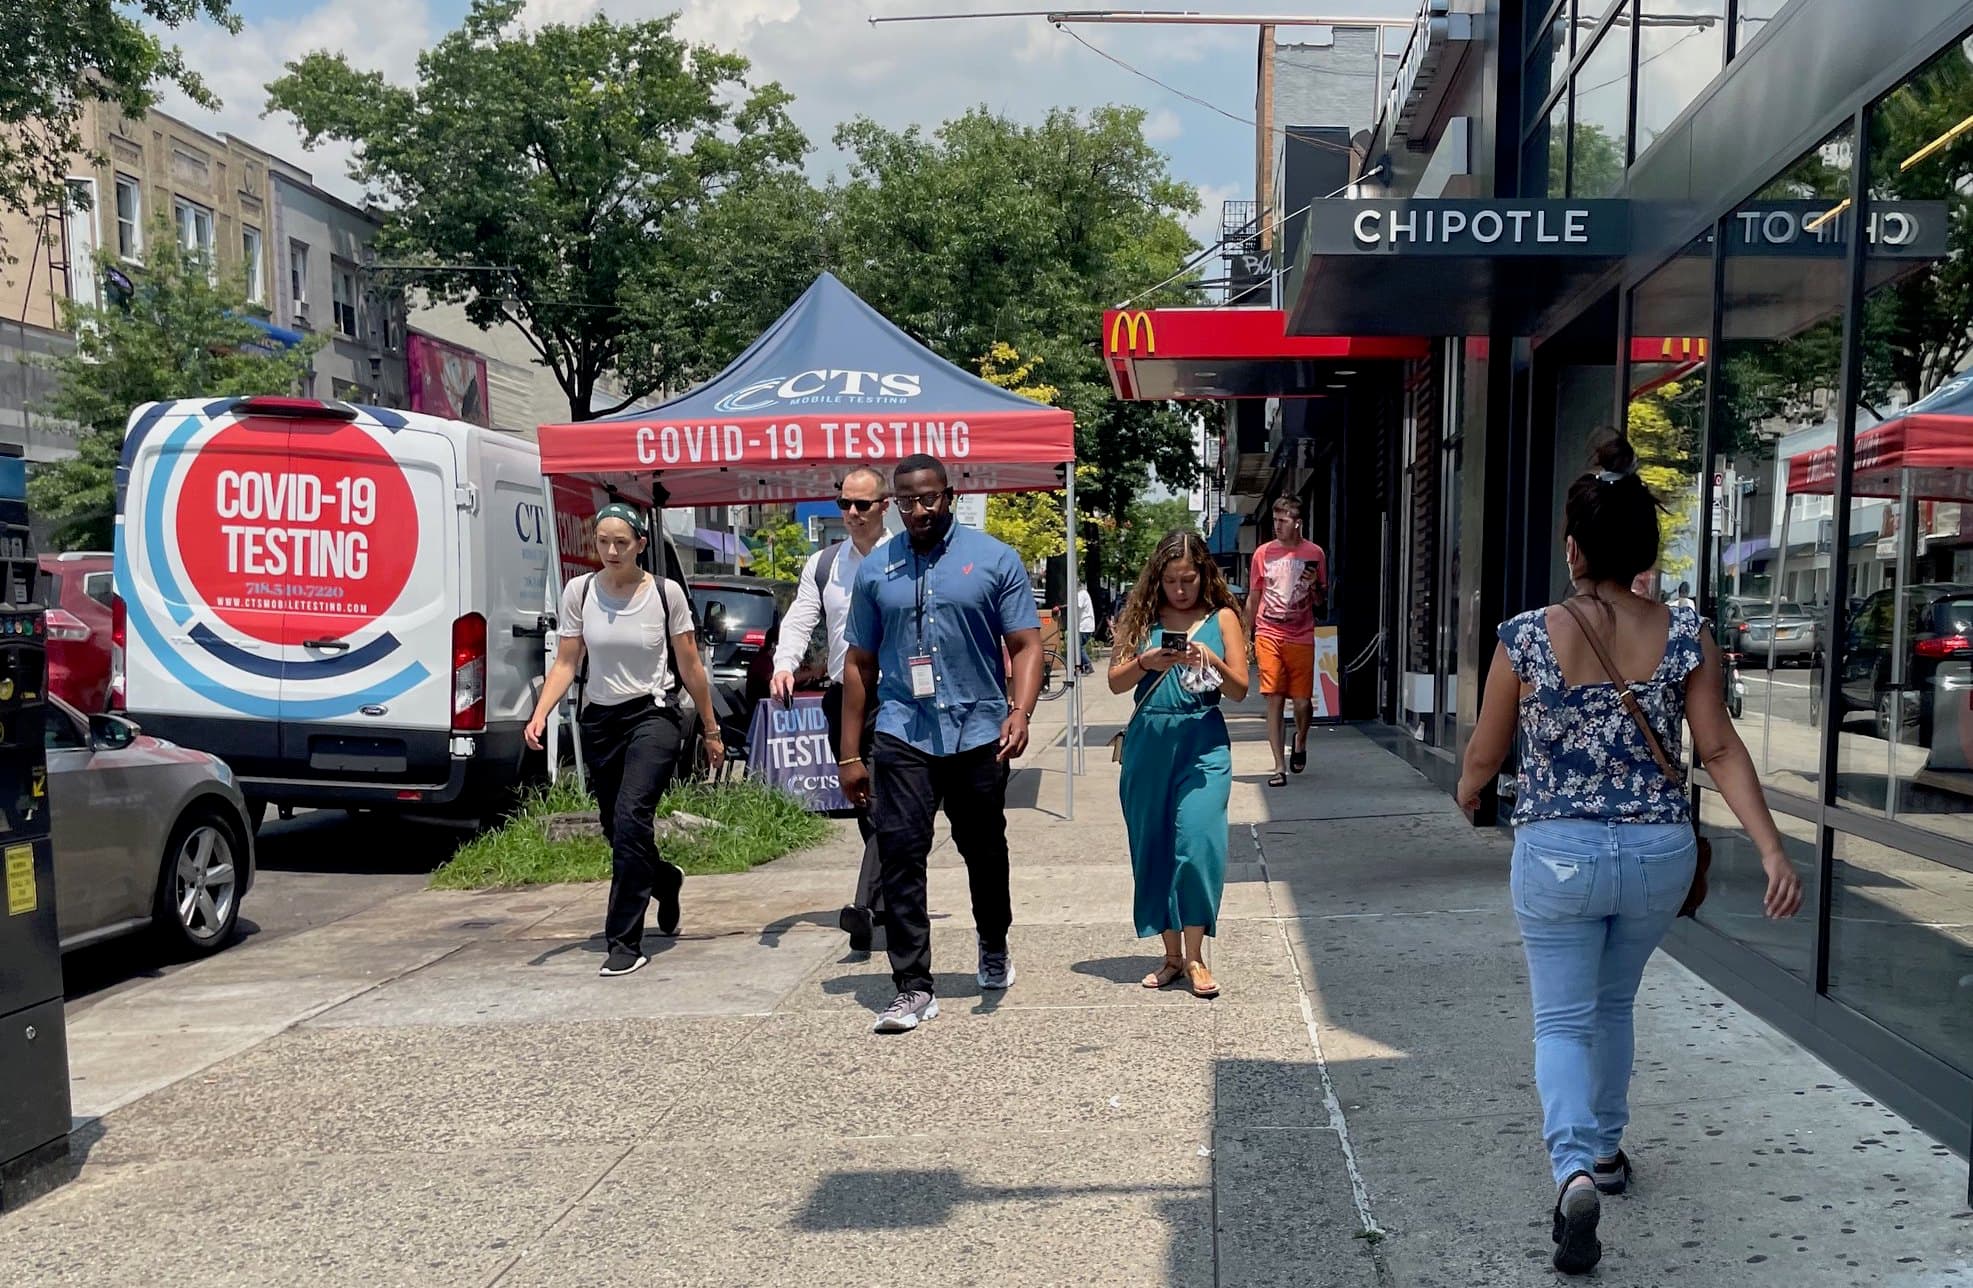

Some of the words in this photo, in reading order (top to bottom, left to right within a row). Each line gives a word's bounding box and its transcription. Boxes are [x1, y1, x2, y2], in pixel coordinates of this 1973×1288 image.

[1353, 209, 1590, 244] CHIPOTLE
[777, 369, 922, 399] CTS
[789, 394, 843, 406] MOBILE
[847, 394, 908, 405] TESTING
[636, 424, 804, 465] COVID-19
[820, 421, 971, 460] TESTING
[216, 469, 377, 526] COVID-19
[515, 501, 548, 544] CT
[221, 525, 369, 580] TESTING
[773, 708, 828, 733] COVID
[767, 735, 836, 769] TESTI
[803, 775, 840, 791] CTS
